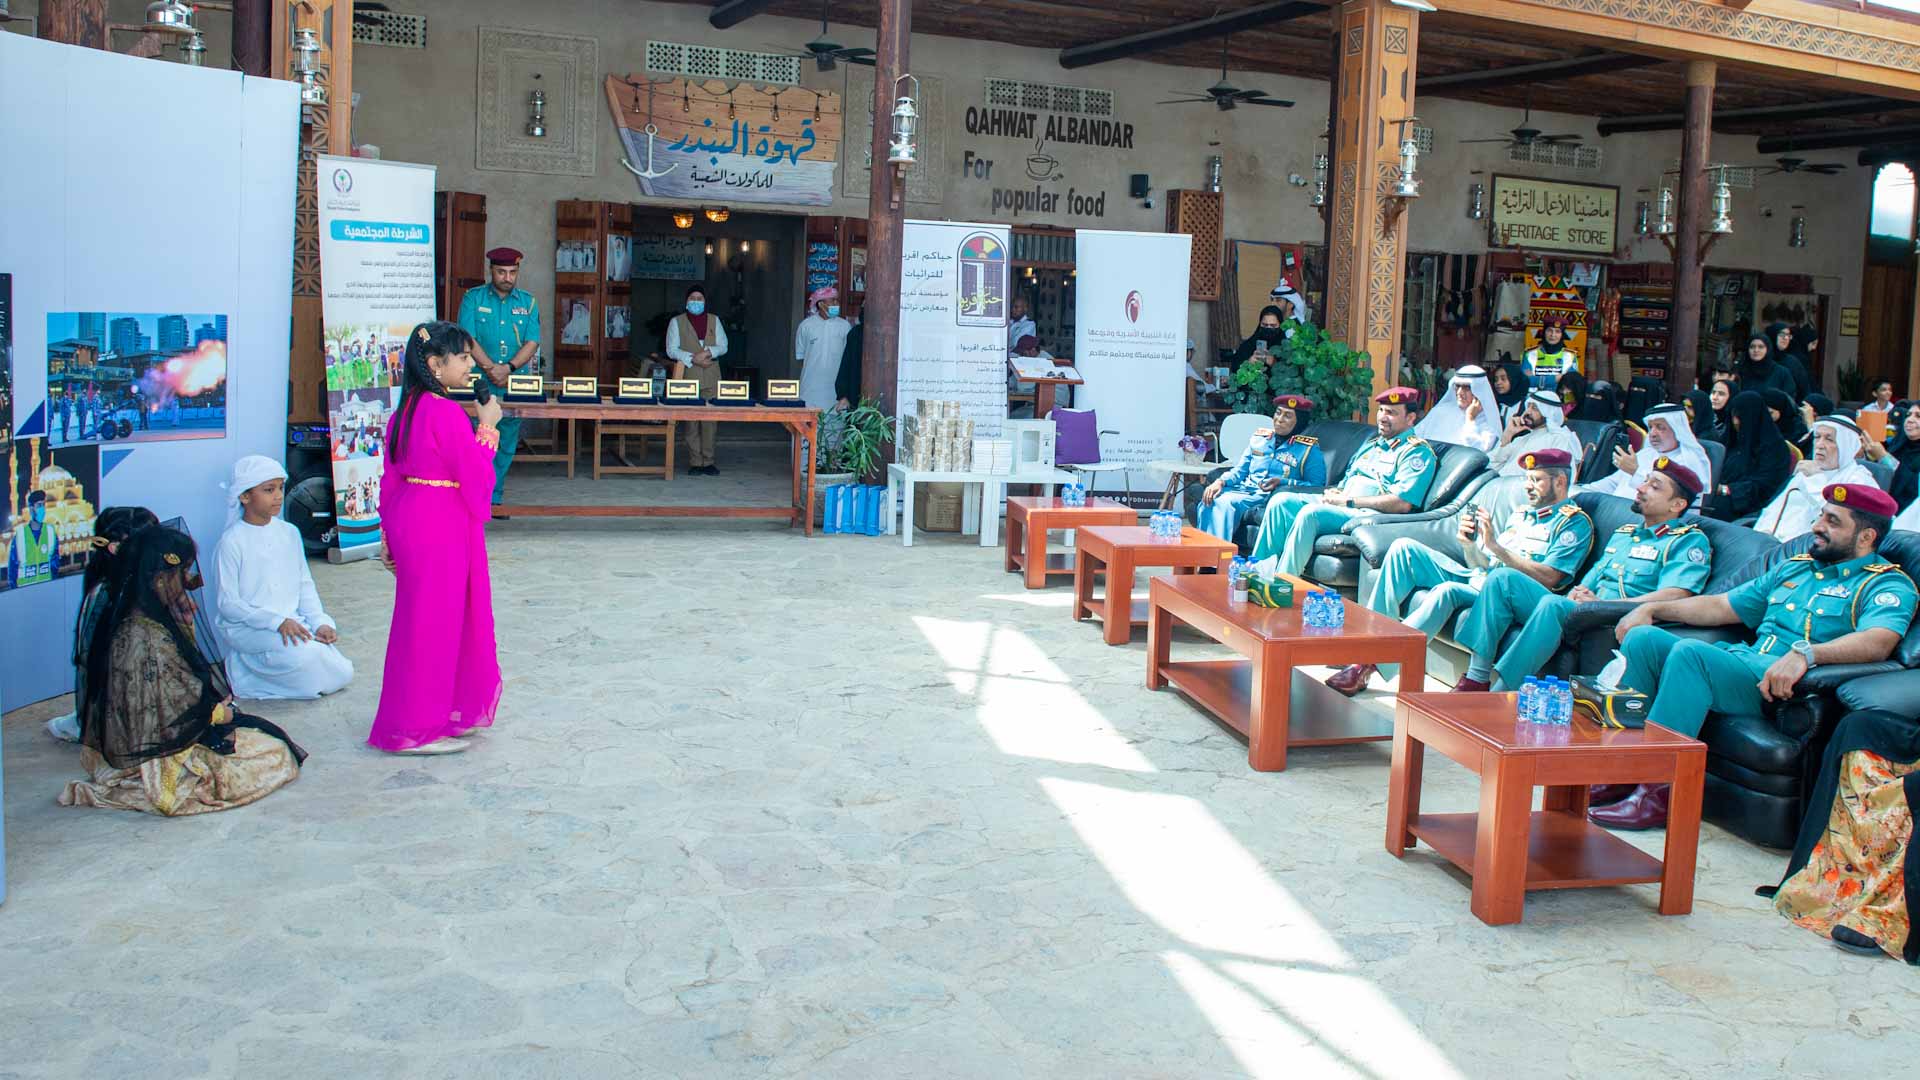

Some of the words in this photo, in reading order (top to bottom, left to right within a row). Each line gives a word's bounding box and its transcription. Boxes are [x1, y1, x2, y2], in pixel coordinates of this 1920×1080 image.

[966, 106, 1037, 139] QAHWAT
[1045, 114, 1133, 148] ALBANDAR
[668, 118, 749, 166] البندر
[755, 119, 816, 167] قهوة
[691, 165, 727, 189] الشعبية
[964, 150, 993, 180] For
[992, 185, 1059, 216] popular
[1067, 188, 1105, 217] food
[1502, 188, 1535, 214] التراثية
[1574, 194, 1609, 222] ماضينا
[344, 224, 390, 239] المجتمعية
[391, 226, 422, 240] الشرطة
[1501, 223, 1560, 241] HERITAGE
[1568, 228, 1607, 245] STORE
